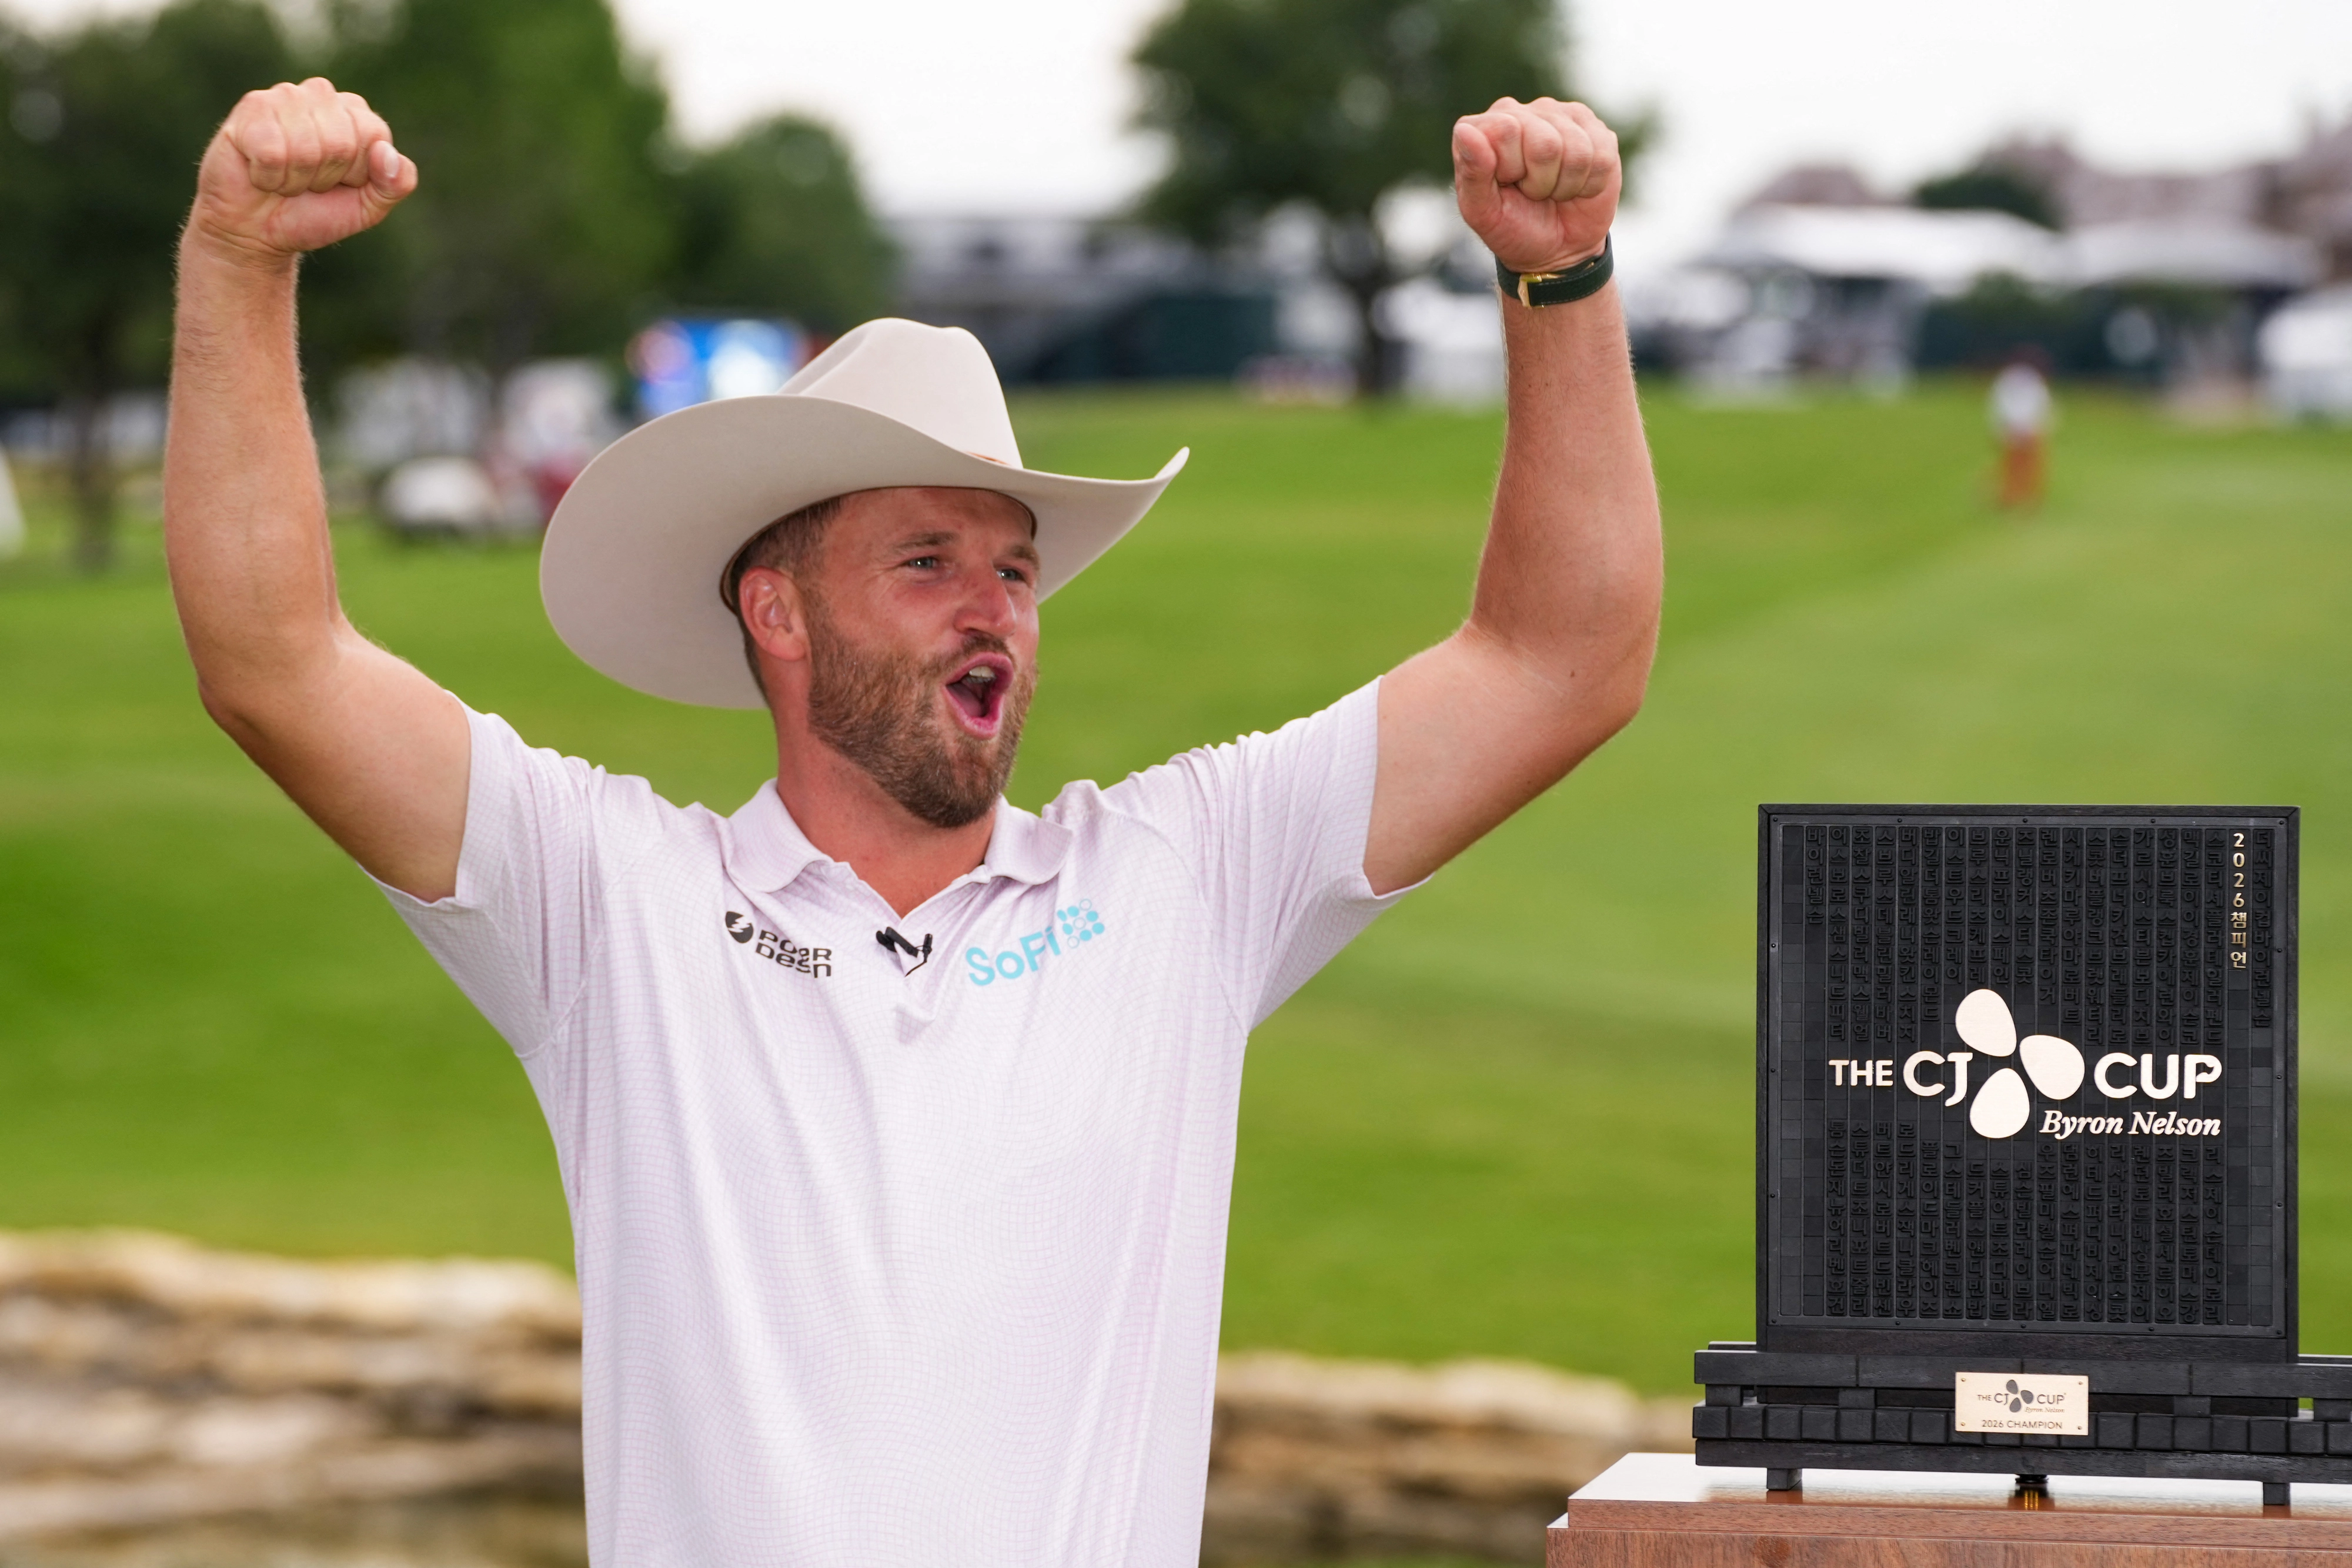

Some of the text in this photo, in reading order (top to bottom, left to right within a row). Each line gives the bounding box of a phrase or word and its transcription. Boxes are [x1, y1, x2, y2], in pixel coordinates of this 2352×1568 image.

[966, 927, 1061, 986] SoFi
[1829, 1051, 2222, 1107] THE CJ CUP
[2039, 1111, 2221, 1140] Byron Nelson
[1994, 1393, 2009, 1406] CJ
[2037, 1394, 2064, 1405] CUP
[1982, 1420, 2063, 1429] 2026 CHAMPION
